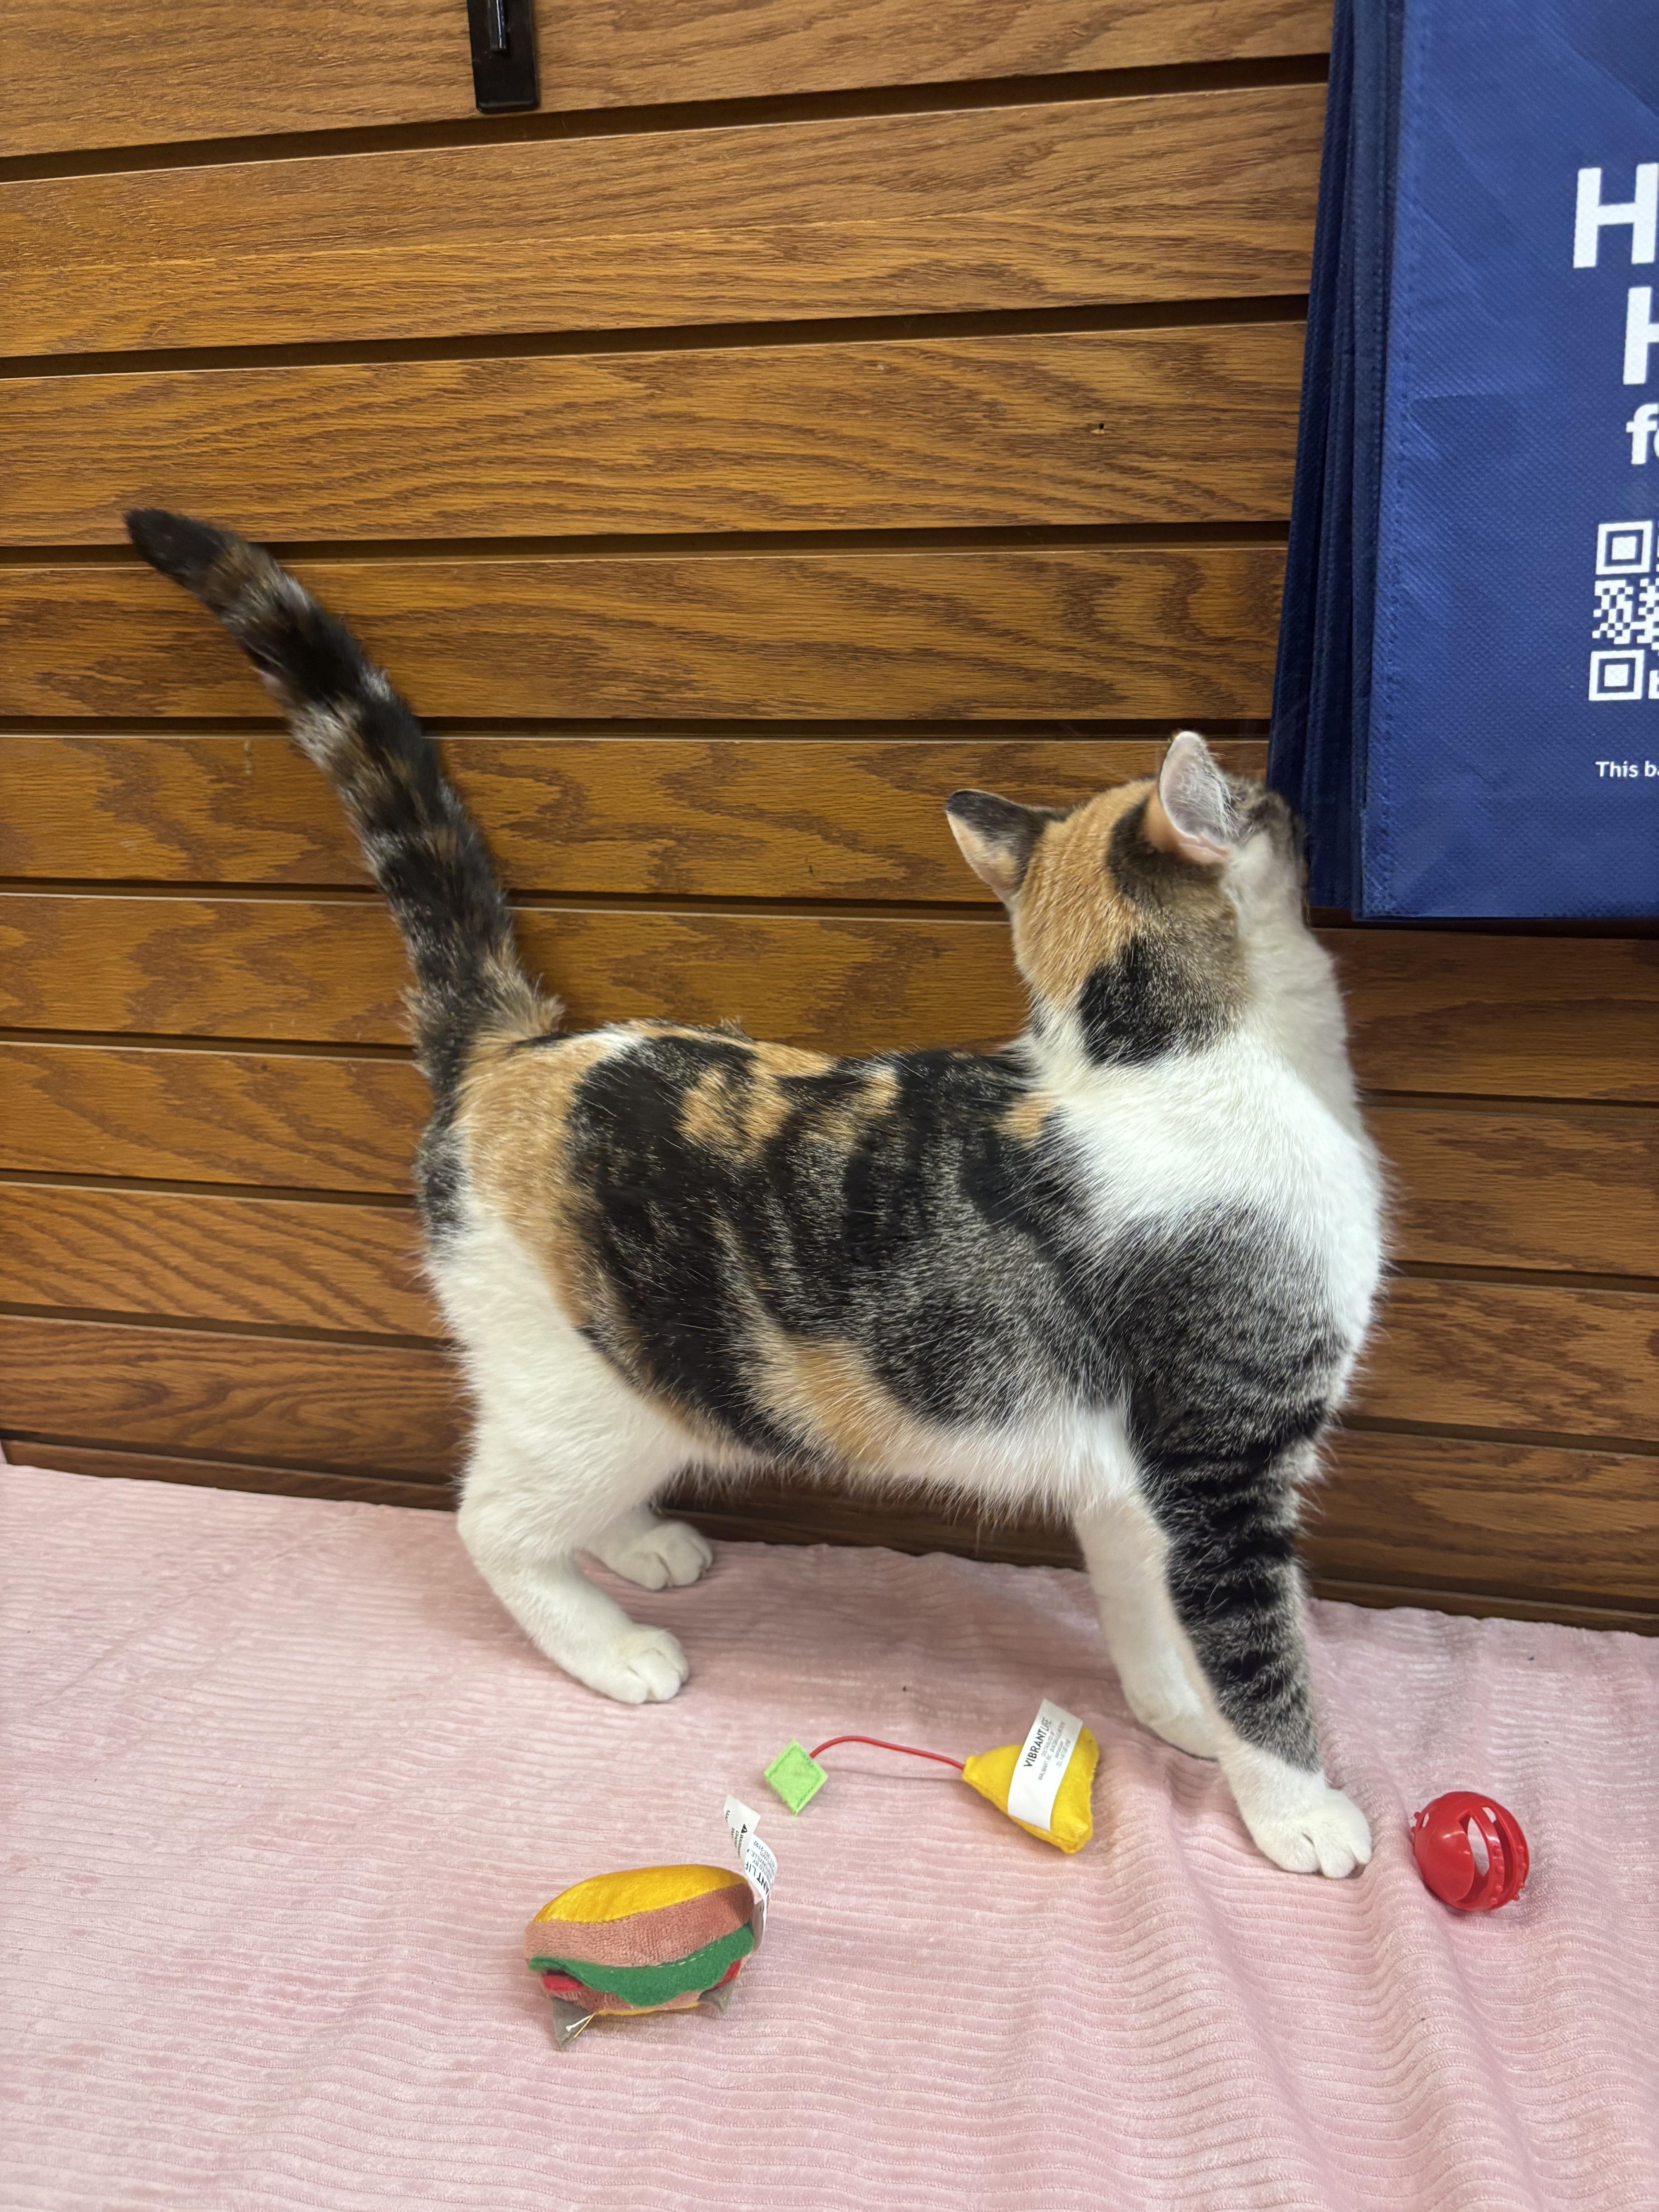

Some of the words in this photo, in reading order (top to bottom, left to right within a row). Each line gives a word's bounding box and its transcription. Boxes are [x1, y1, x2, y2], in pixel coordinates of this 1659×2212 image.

[1626, 403, 1659, 465] f
[1595, 761, 1638, 778] This
[1644, 760, 1659, 777] b
[1023, 1728, 1047, 1767] VIBRANT
[745, 1862, 756, 1877] LIF
